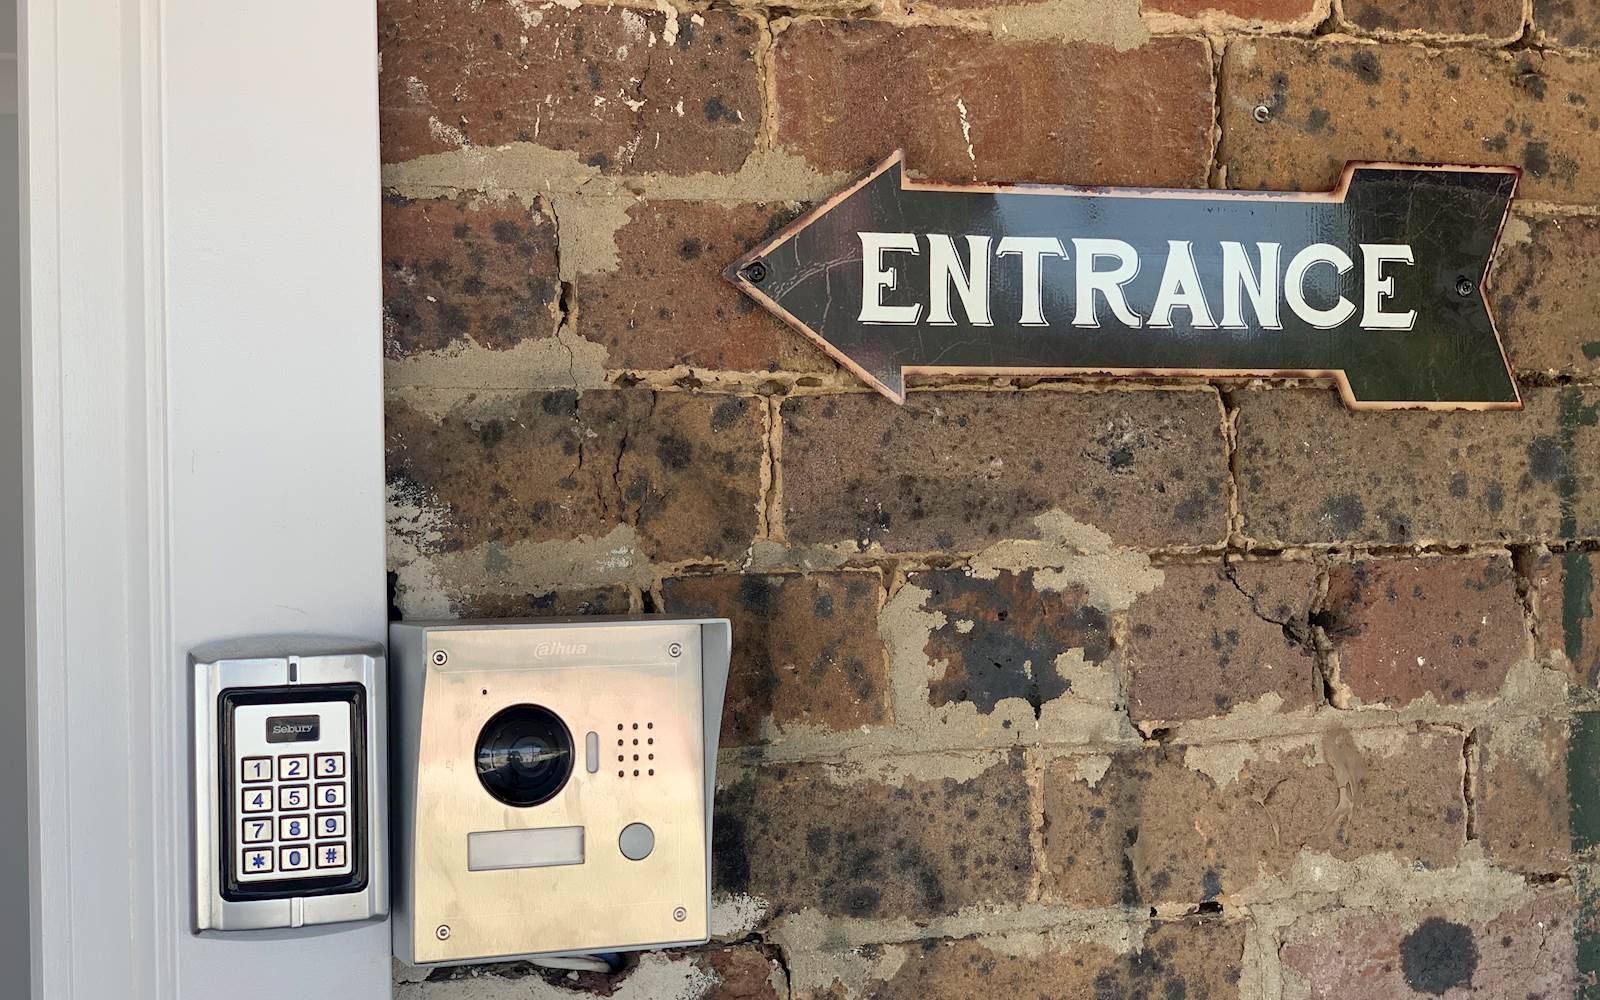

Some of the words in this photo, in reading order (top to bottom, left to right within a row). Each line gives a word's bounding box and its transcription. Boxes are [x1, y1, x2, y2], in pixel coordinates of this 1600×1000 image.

[857, 231, 1419, 331] ENTRANCE
[272, 724, 313, 734] Sebury
[253, 762, 261, 778] 1
[288, 760, 301, 776] 2
[324, 758, 337, 773] 3
[252, 792, 264, 808] 4
[289, 790, 300, 805] 5
[325, 788, 337, 803] 6
[252, 823, 265, 838] 7
[289, 820, 301, 836] 8
[325, 818, 337, 833] 9
[289, 850, 301, 866] 0
[325, 848, 337, 863] #
